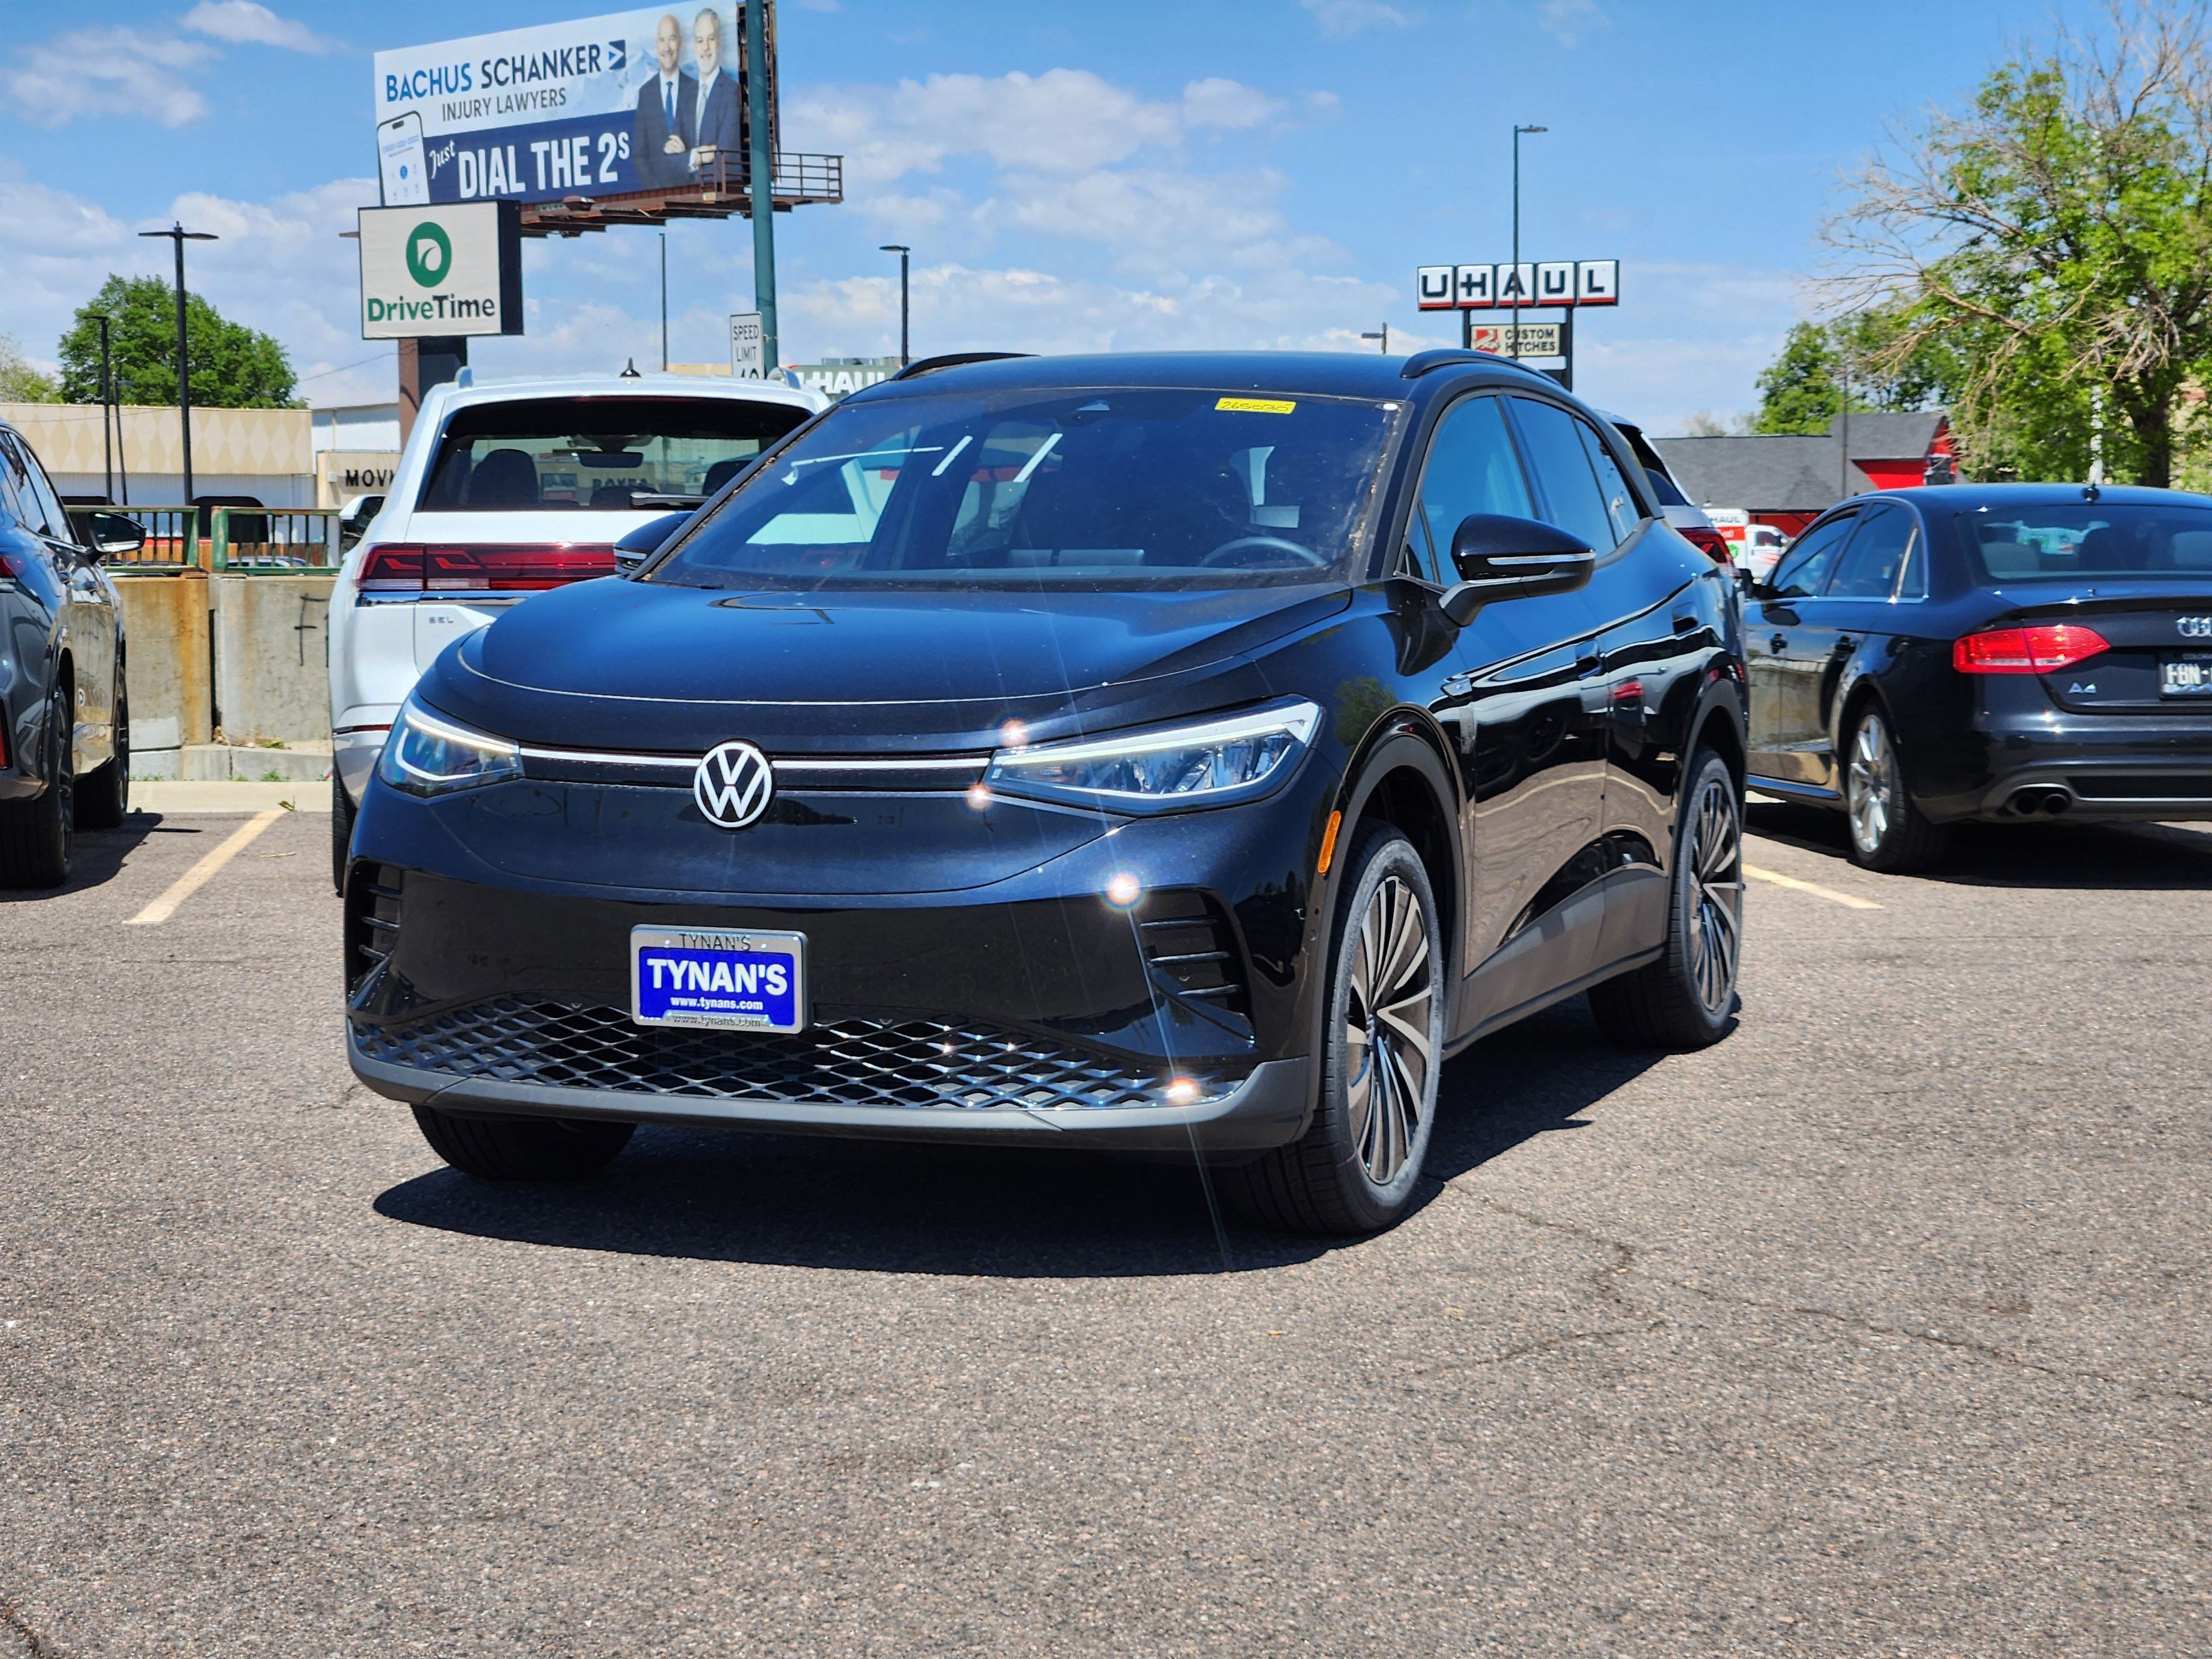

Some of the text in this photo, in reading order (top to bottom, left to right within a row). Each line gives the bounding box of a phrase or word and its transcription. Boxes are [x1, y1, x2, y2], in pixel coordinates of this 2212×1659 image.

[387, 44, 601, 102] BACHUS SCHANKER
[442, 87, 566, 122] INJURY LAWYERS
[429, 140, 456, 179] Just
[458, 145, 525, 199] DIAL
[531, 136, 592, 190] THE
[367, 293, 495, 322] DriveTime
[733, 325, 759, 340] SPEED
[735, 346, 757, 362] LIMIT
[1505, 341, 1556, 352] HTCHES
[2068, 682, 2098, 693] A4
[679, 933, 750, 951] TYNAN'S
[646, 958, 788, 996] TYNAN'S
[670, 997, 764, 1011] www.tynans.com
